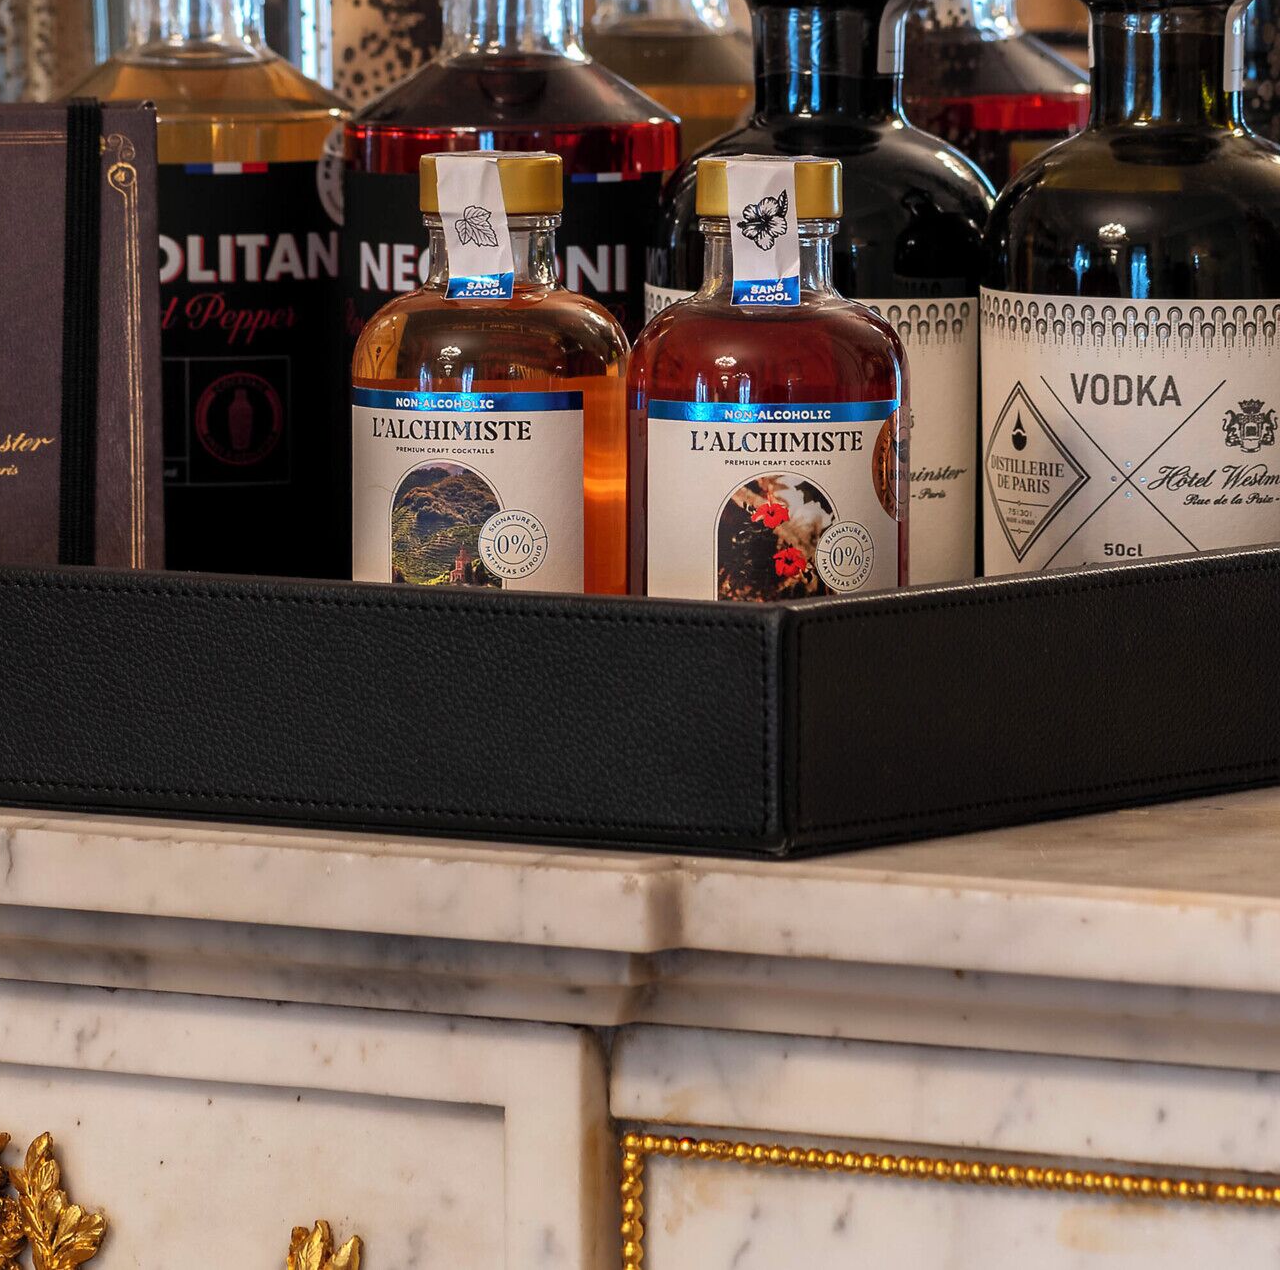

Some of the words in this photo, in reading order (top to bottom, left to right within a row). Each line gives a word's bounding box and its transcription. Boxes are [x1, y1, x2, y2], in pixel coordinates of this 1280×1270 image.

[359, 240, 629, 293] NENI
[456, 287, 506, 297] ALCOOL
[466, 280, 500, 290] SANS
[750, 283, 784, 295] SANS
[740, 292, 792, 302] ALCOOL
[185, 292, 296, 345] Pepper
[1070, 372, 1182, 407] VODKA
[395, 397, 494, 409] NON-ALCOHOLIC
[724, 409, 831, 420] NON-ALCOHOLIC
[372, 417, 532, 441] L'ALCHIMISTE
[690, 430, 863, 453] L'ALCHIMISTE
[991, 454, 1065, 478] DISTILLERIE
[997, 473, 1010, 490] DE
[1012, 476, 1050, 494] PARIS
[1147, 465, 1217, 491] Hôtel
[918, 487, 946, 500] Paris
[1183, 493, 1210, 505] Rue
[1213, 494, 1227, 505] de
[1230, 493, 1243, 505] la
[1245, 492, 1273, 504] Paix
[488, 514, 531, 533] SIGNATURE
[531, 523, 540, 533] BY
[497, 534, 530, 554] 0%
[825, 526, 861, 545] SIGNATURE
[862, 534, 869, 543] BY
[485, 545, 517, 575] MATTHIAS
[520, 545, 542, 573] GIROUD
[833, 546, 861, 567] 0%
[1104, 543, 1143, 557] 50cl
[822, 558, 850, 587] MATTHIAS
[852, 556, 871, 585] GIROUD
